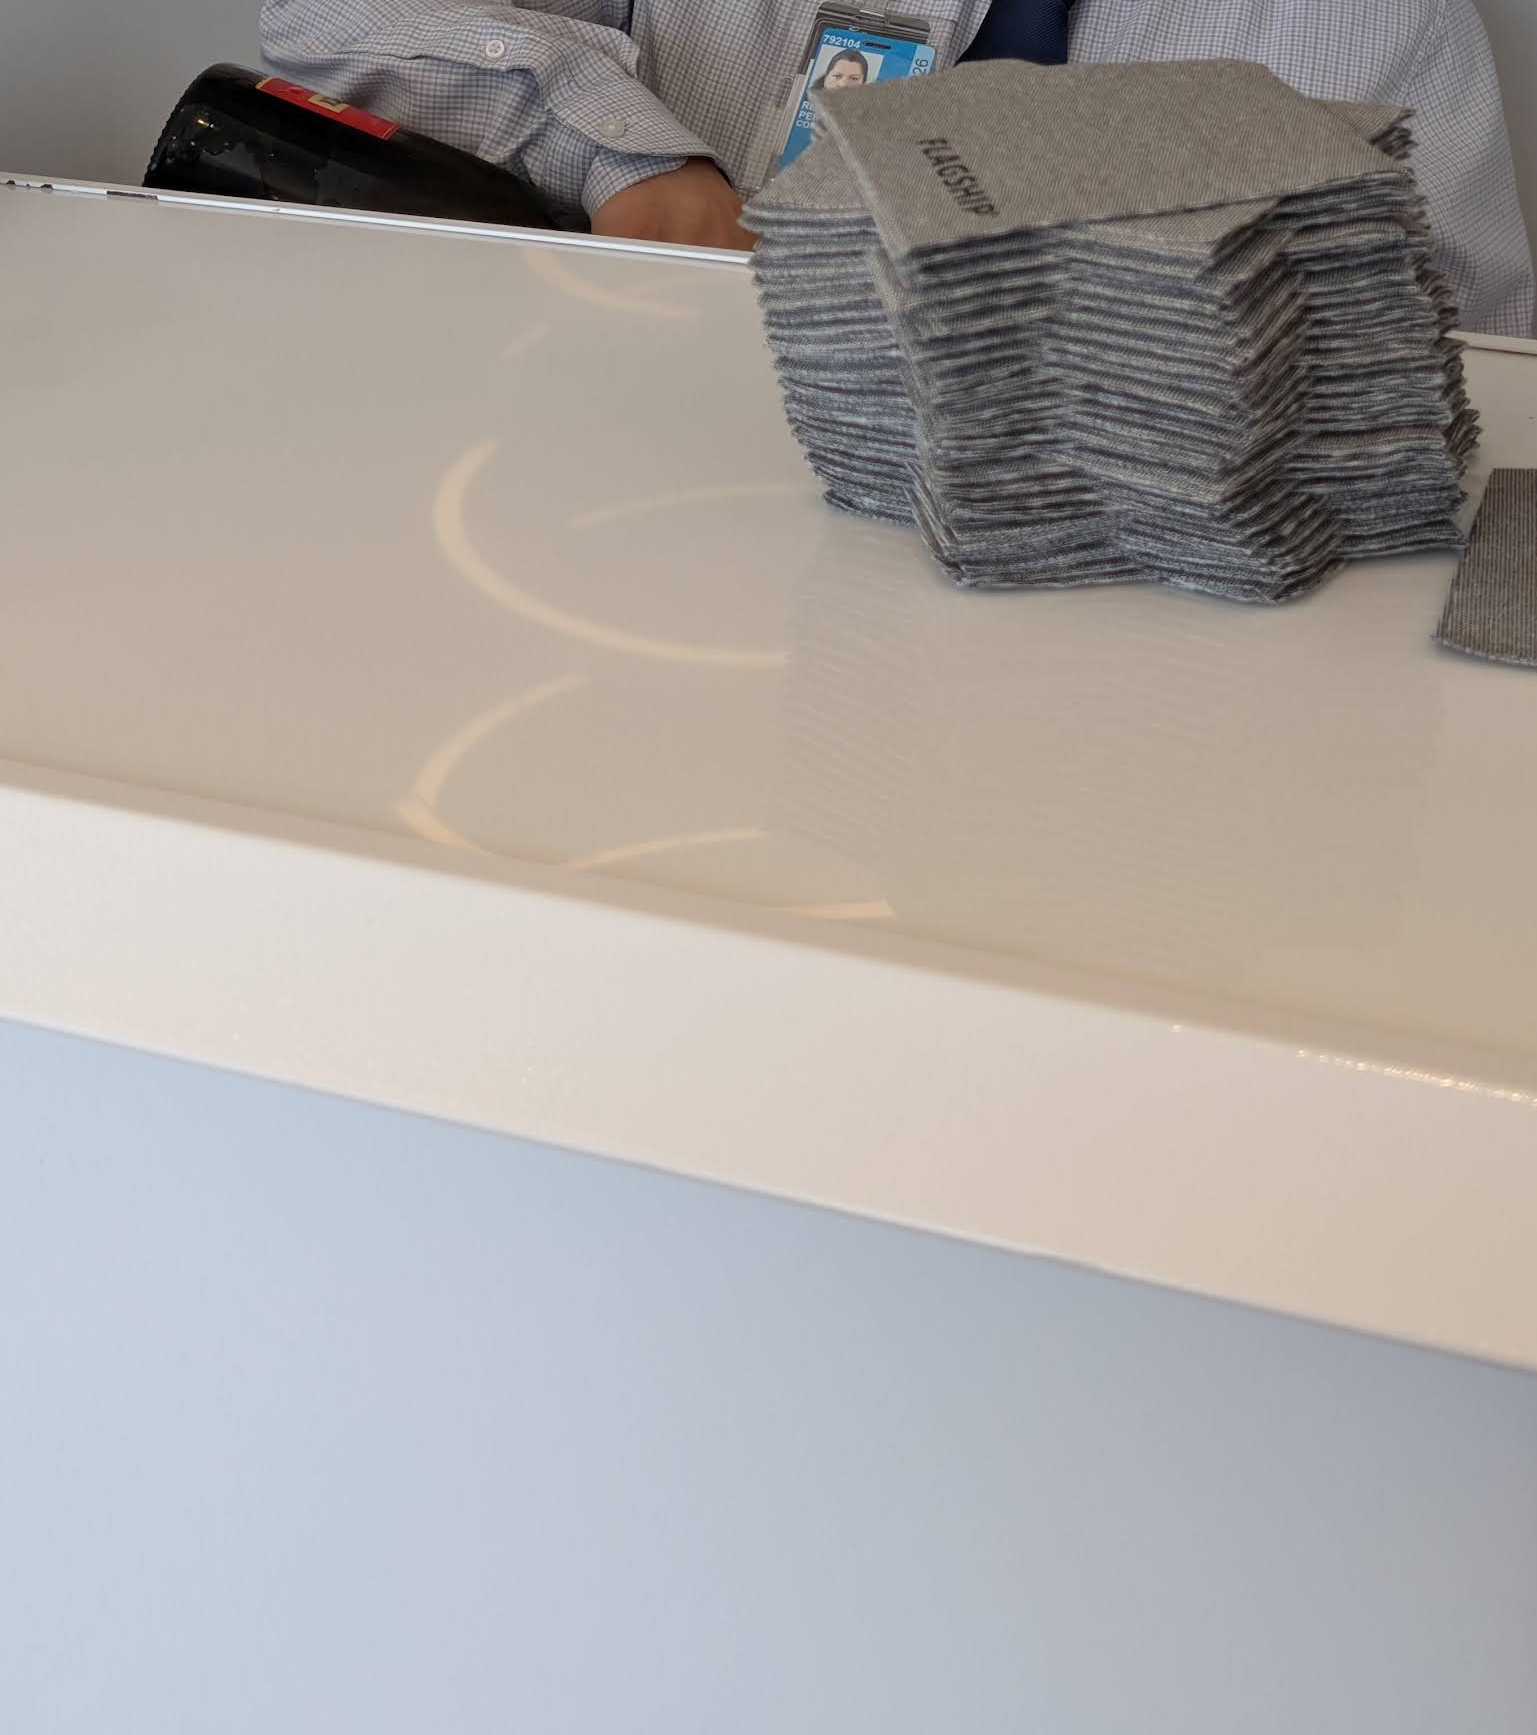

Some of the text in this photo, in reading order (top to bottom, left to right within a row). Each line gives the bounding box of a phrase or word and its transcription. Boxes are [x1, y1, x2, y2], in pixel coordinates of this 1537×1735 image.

[823, 34, 861, 50] 792104
[912, 58, 929, 76] 26
[916, 137, 997, 216] FLAGSHIP
